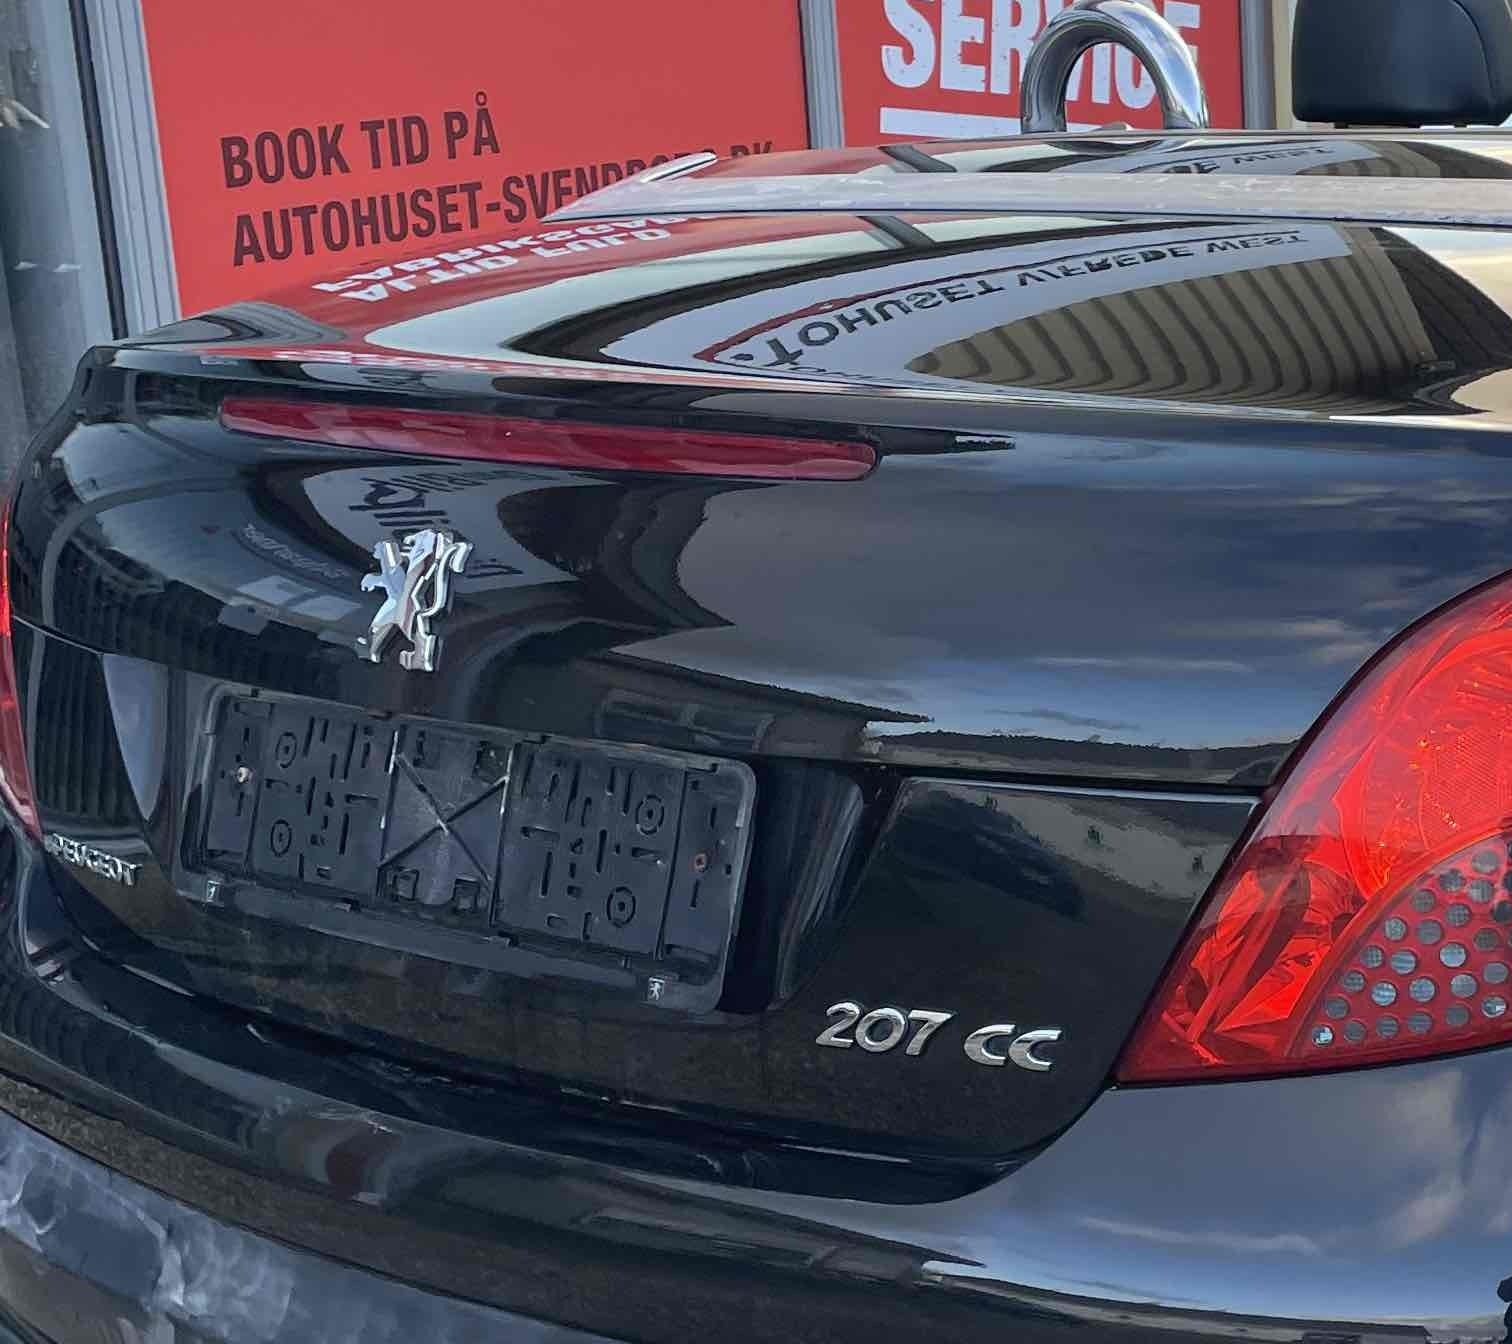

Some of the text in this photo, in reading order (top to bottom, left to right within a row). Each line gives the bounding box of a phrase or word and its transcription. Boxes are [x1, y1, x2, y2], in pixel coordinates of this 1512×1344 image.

[220, 91, 500, 189] BOOK TID PÅ
[815, 1001, 1063, 1072] 207 CC
